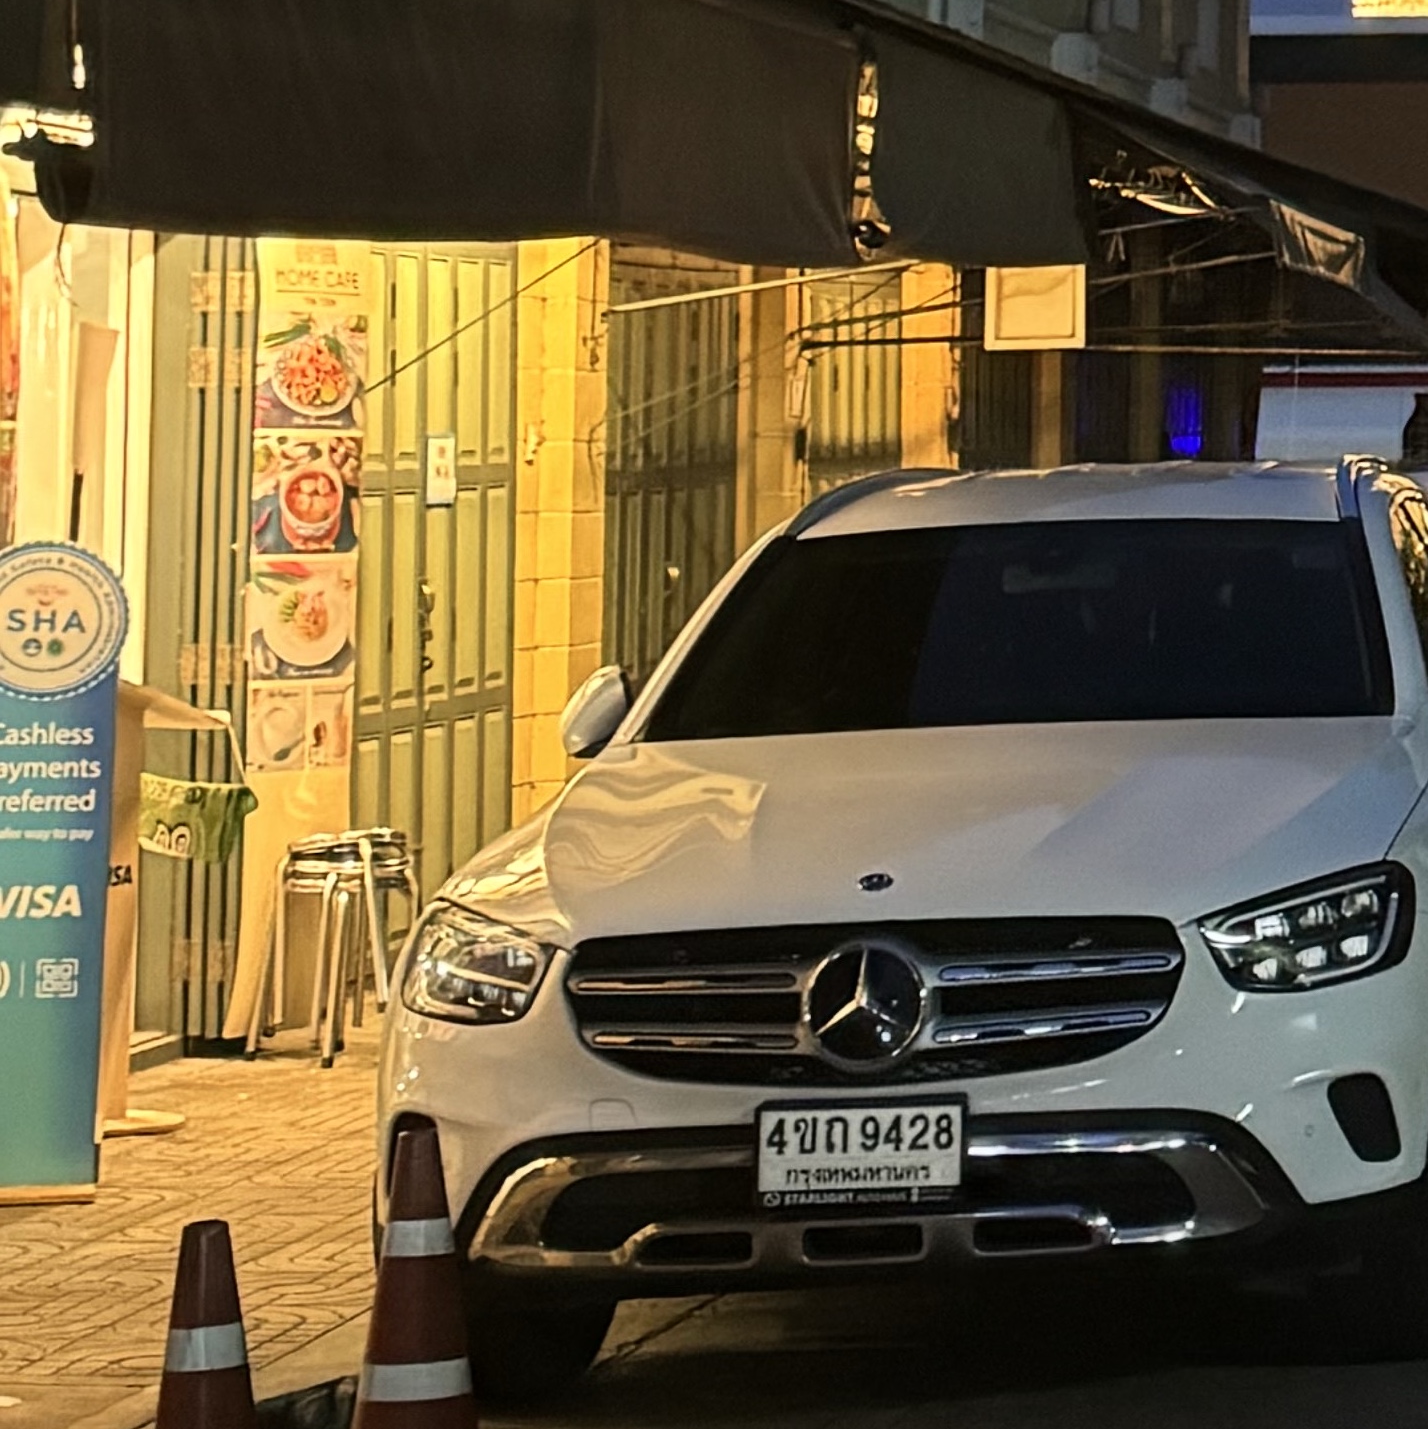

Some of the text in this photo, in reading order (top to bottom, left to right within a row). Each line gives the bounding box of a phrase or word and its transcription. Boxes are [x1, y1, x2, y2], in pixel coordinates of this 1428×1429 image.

[276, 270, 360, 290] HOME CAFE
[7, 609, 86, 633] SHA
[0, 759, 102, 784] ayments
[0, 788, 96, 812] referred
[0, 884, 82, 918] VISA
[766, 1114, 954, 1155] 4ขถ 9428
[786, 1164, 931, 1191] กรุงเทพมหานคร
